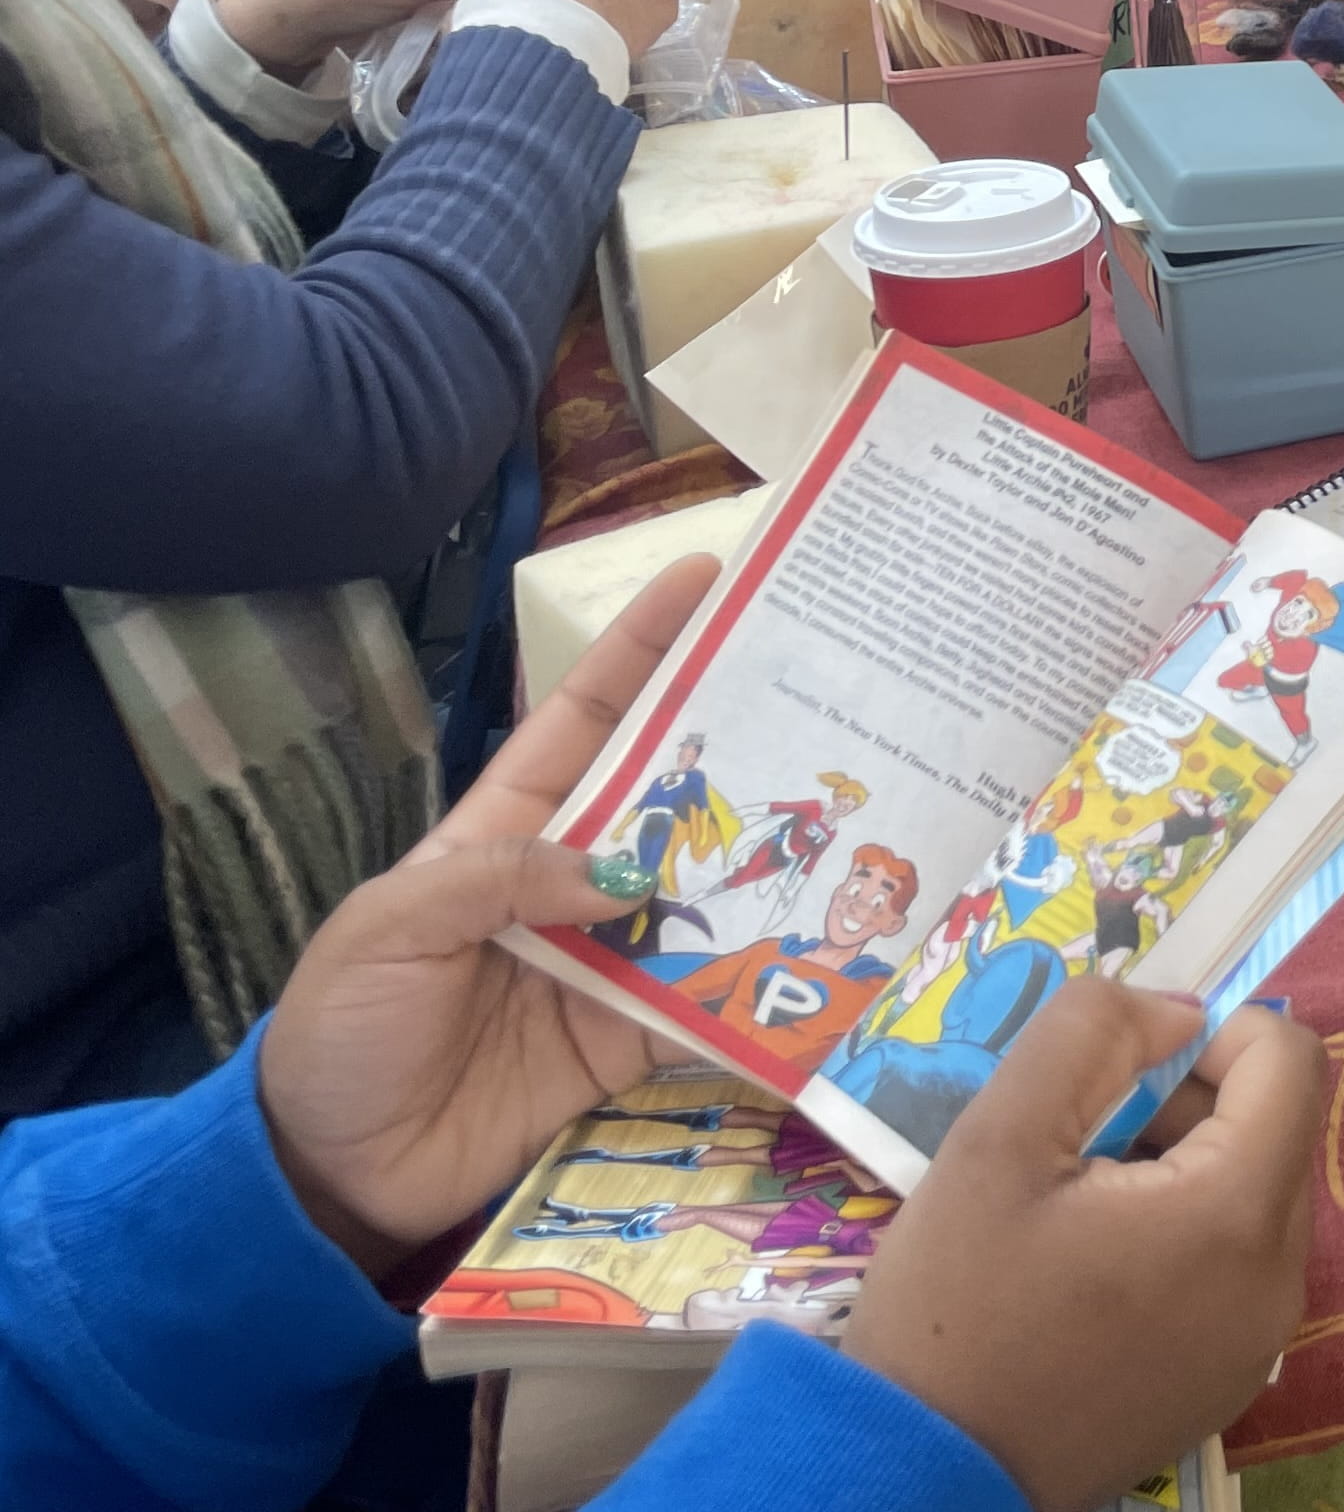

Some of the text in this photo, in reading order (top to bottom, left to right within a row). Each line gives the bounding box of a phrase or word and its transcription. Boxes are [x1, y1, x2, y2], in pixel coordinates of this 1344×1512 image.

[927, 441, 1148, 568] by Dexter Taylor and Jon D'Agostino
[975, 426, 1137, 521] the Attack of the Mole Men!
[981, 448, 1014, 474] Little
[1011, 464, 1053, 494] Archie
[1079, 500, 1113, 526] 1967
[982, 410, 1150, 508] Little Captain Pureheart and
[821, 704, 847, 727] The
[844, 717, 874, 741] New
[870, 731, 903, 759] York
[900, 749, 945, 783] Times,
[942, 772, 970, 796] The
[966, 786, 1008, 820] Daily
[974, 769, 1018, 805] Hugh
[753, 969, 823, 1026] P
